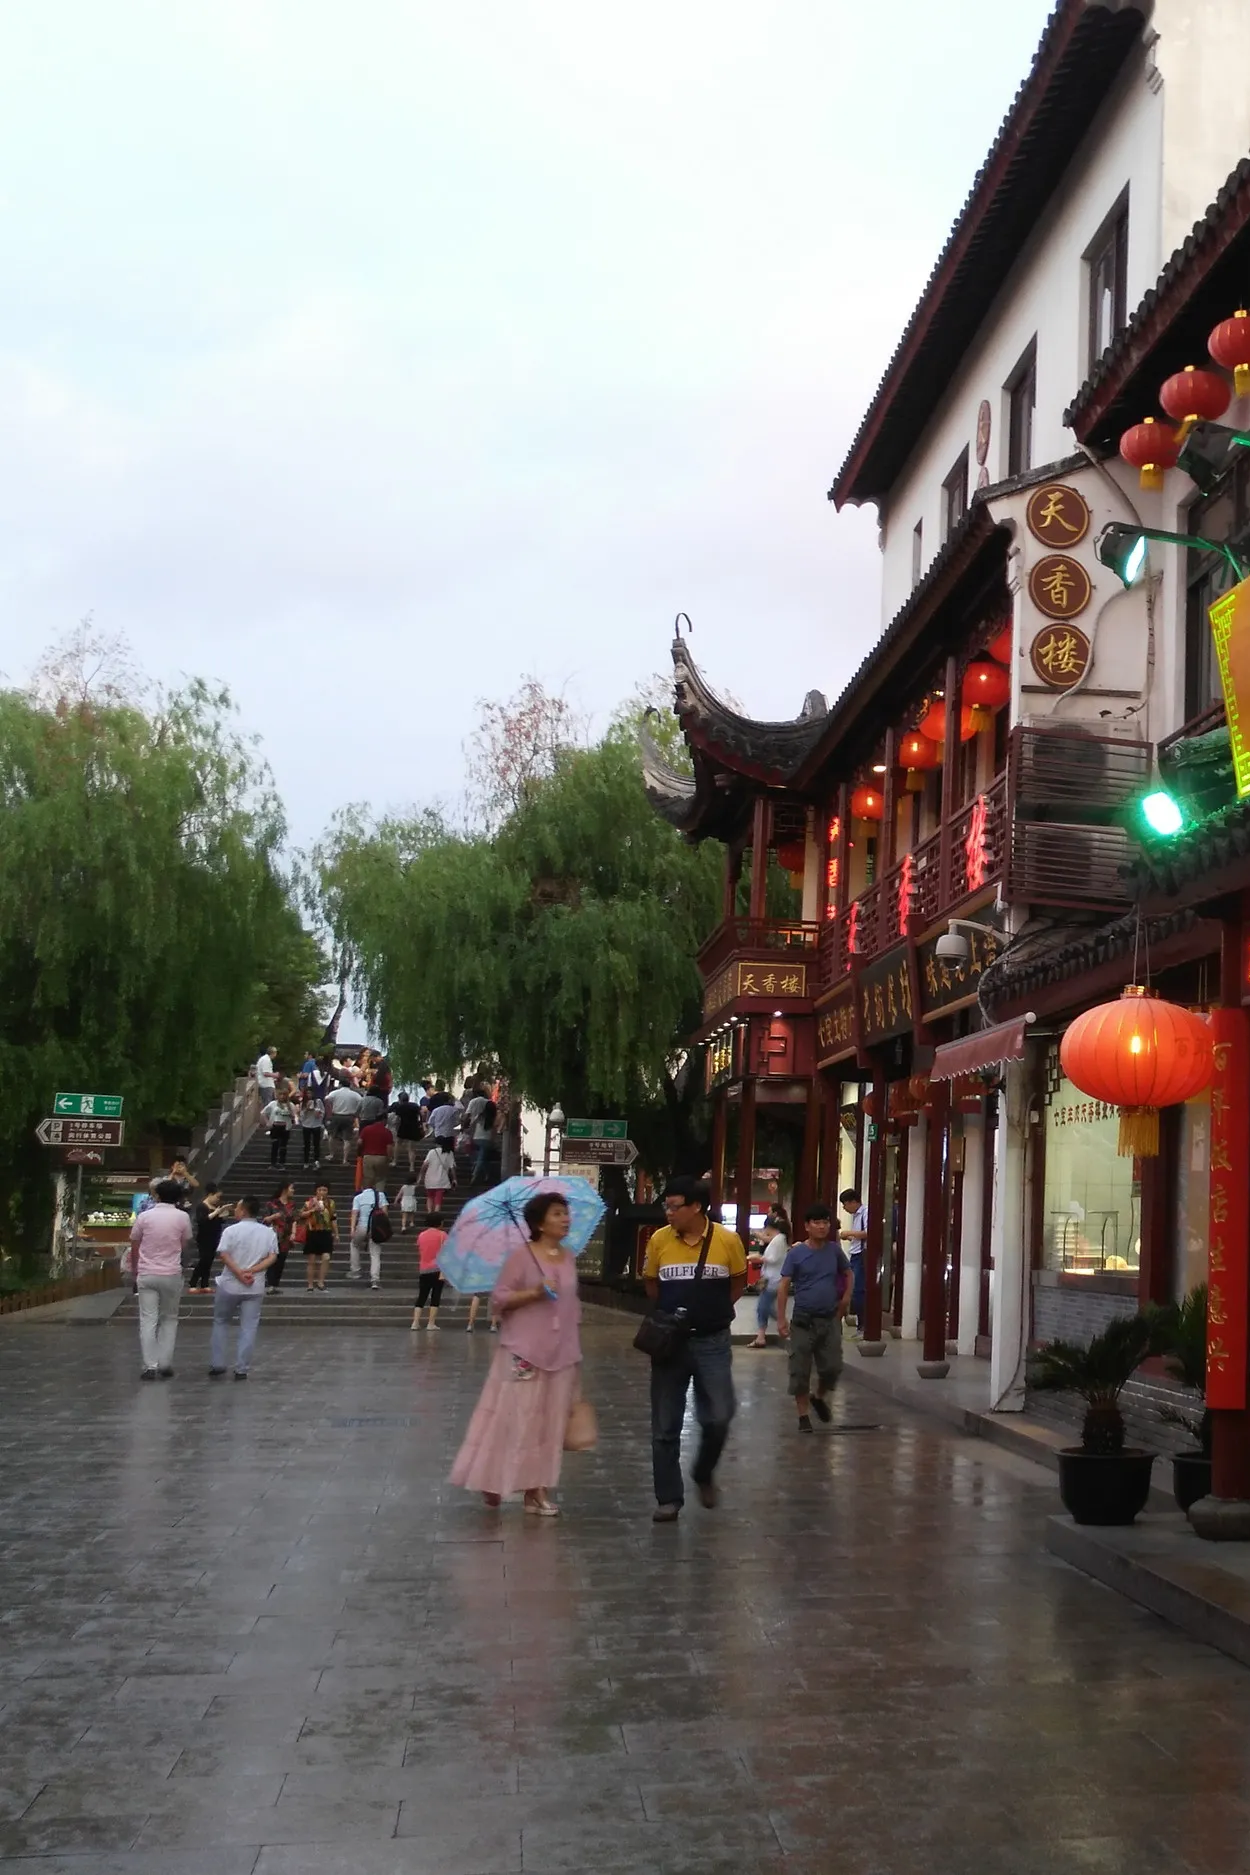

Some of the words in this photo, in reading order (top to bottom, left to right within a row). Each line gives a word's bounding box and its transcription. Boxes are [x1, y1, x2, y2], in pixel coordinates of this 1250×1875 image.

[1038, 491, 1085, 674] 天香楼
[742, 973, 802, 994] 天香楼
[662, 1265, 719, 1279] HILFIER
